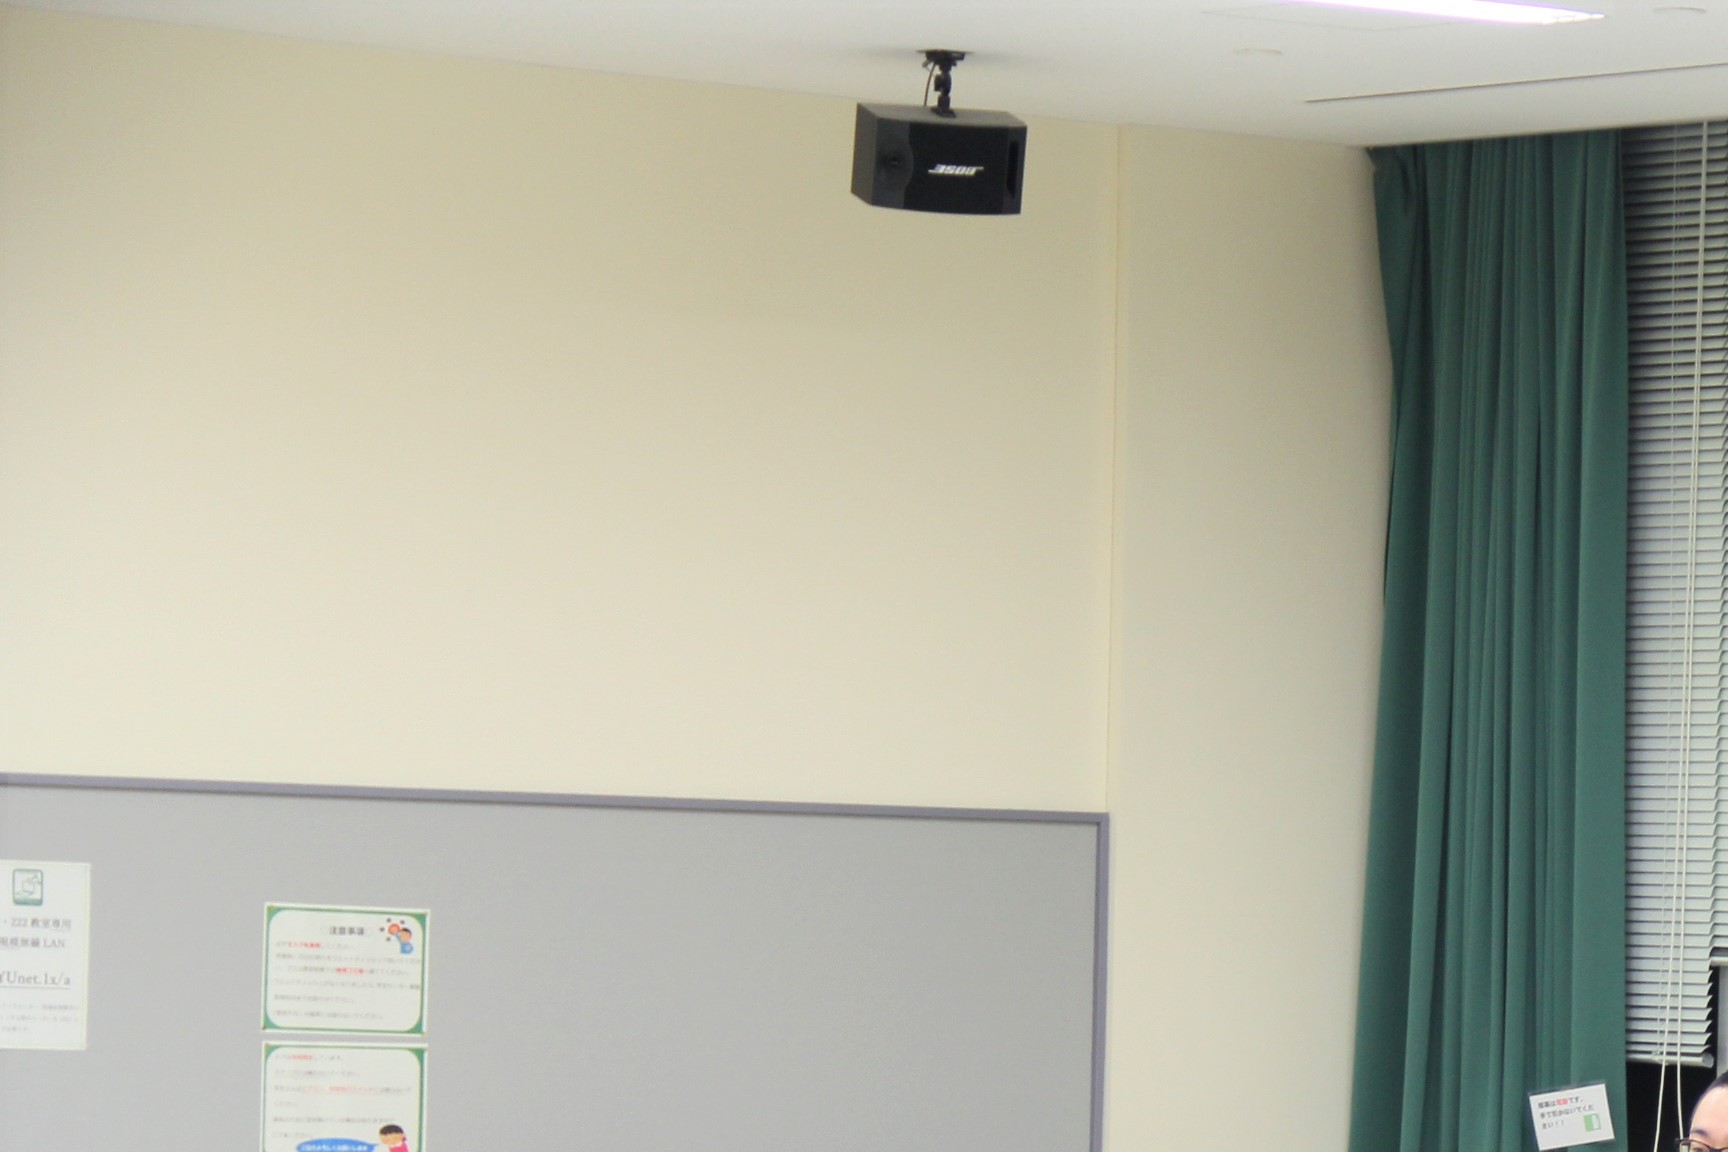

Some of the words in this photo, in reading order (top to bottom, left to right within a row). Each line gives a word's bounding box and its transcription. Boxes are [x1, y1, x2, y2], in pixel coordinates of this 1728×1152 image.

[328, 926, 365, 936] 注意事項
[43, 938, 66, 948] LAN
